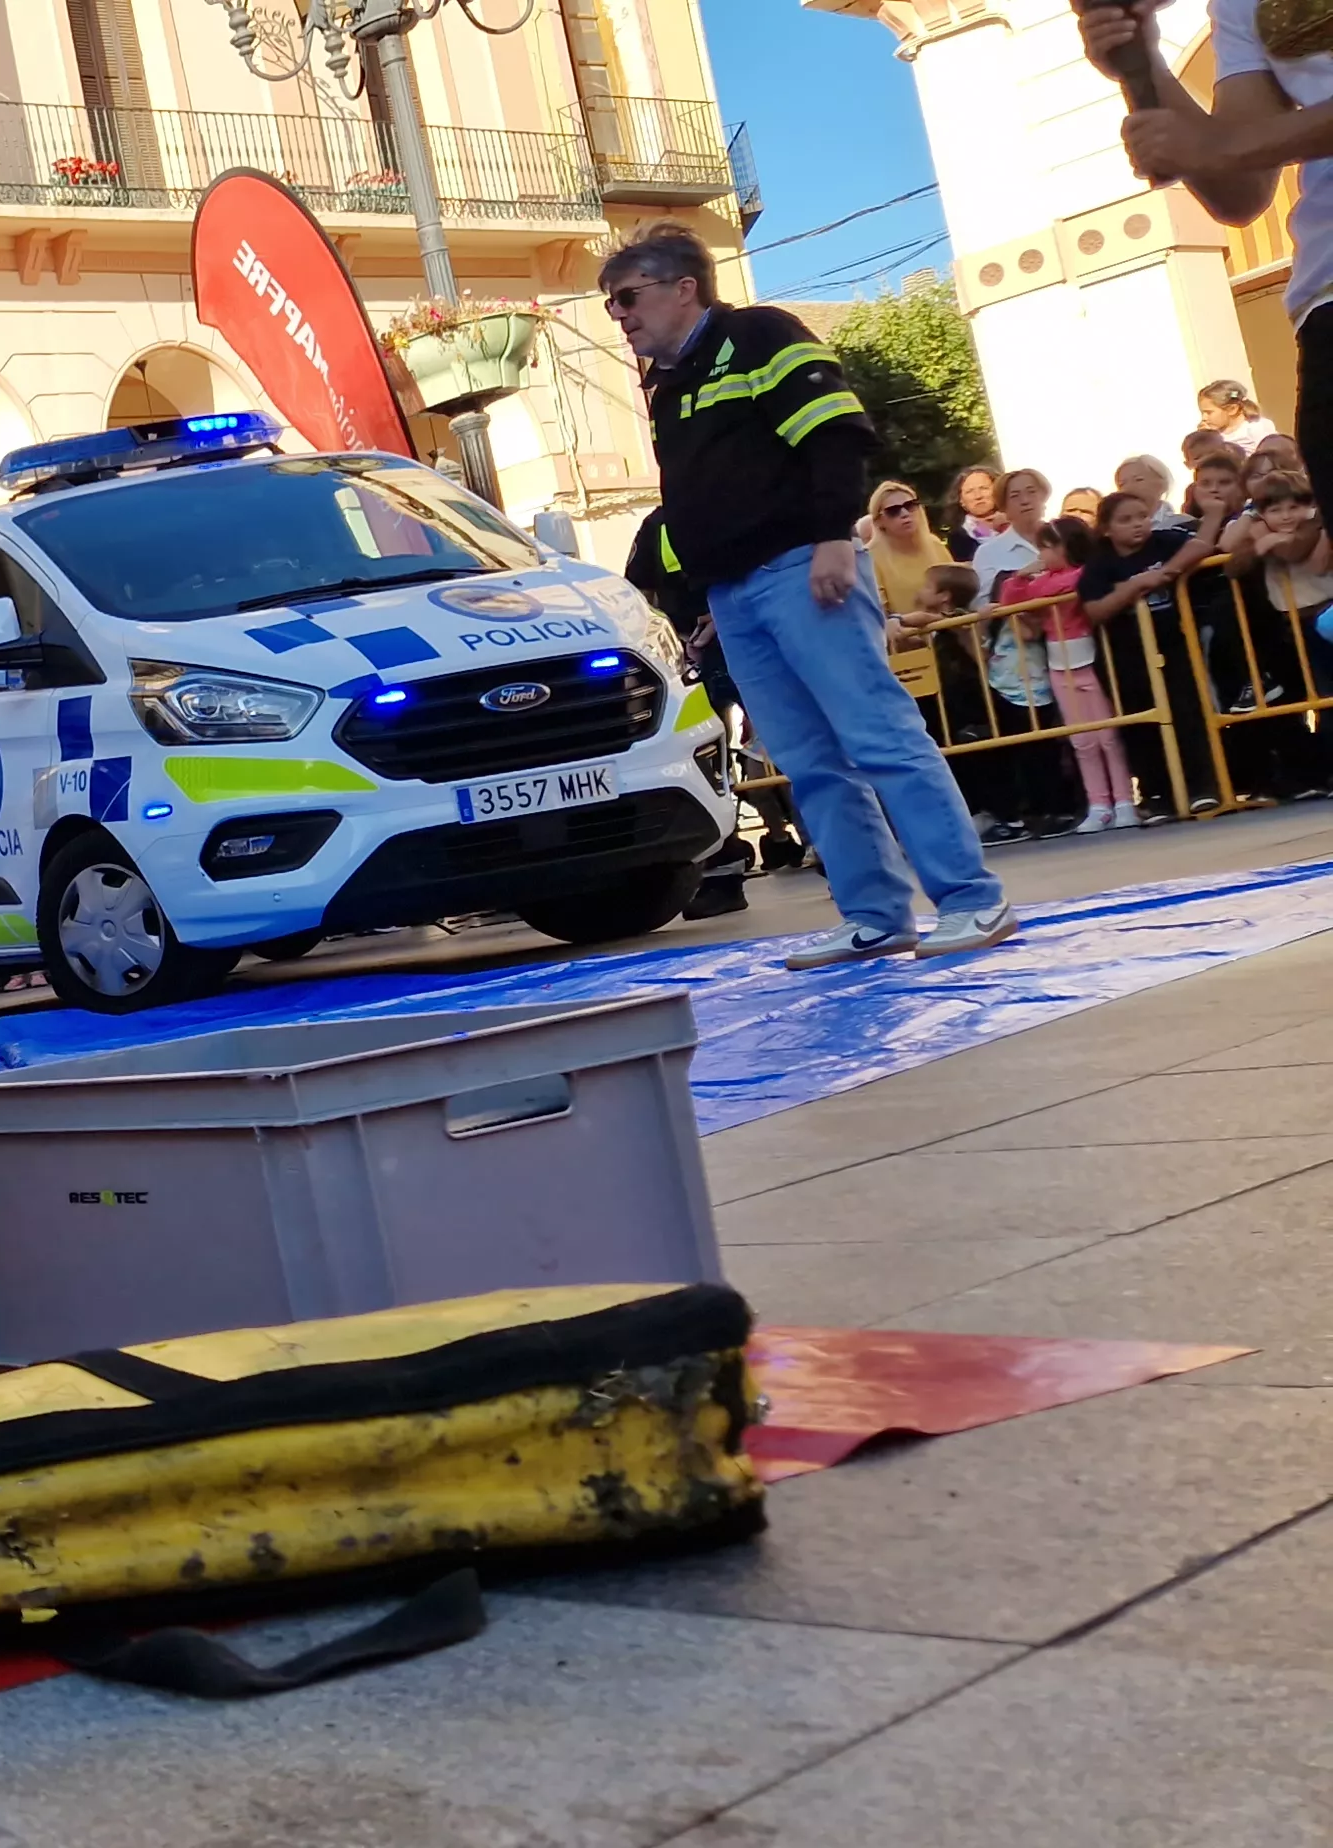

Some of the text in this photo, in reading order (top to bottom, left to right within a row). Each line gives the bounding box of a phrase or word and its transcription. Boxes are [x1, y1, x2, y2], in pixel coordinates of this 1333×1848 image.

[459, 619, 609, 651] POLICIA
[499, 685, 537, 705] Ford
[60, 770, 87, 794] V-10
[477, 768, 611, 815] 3557 MHK
